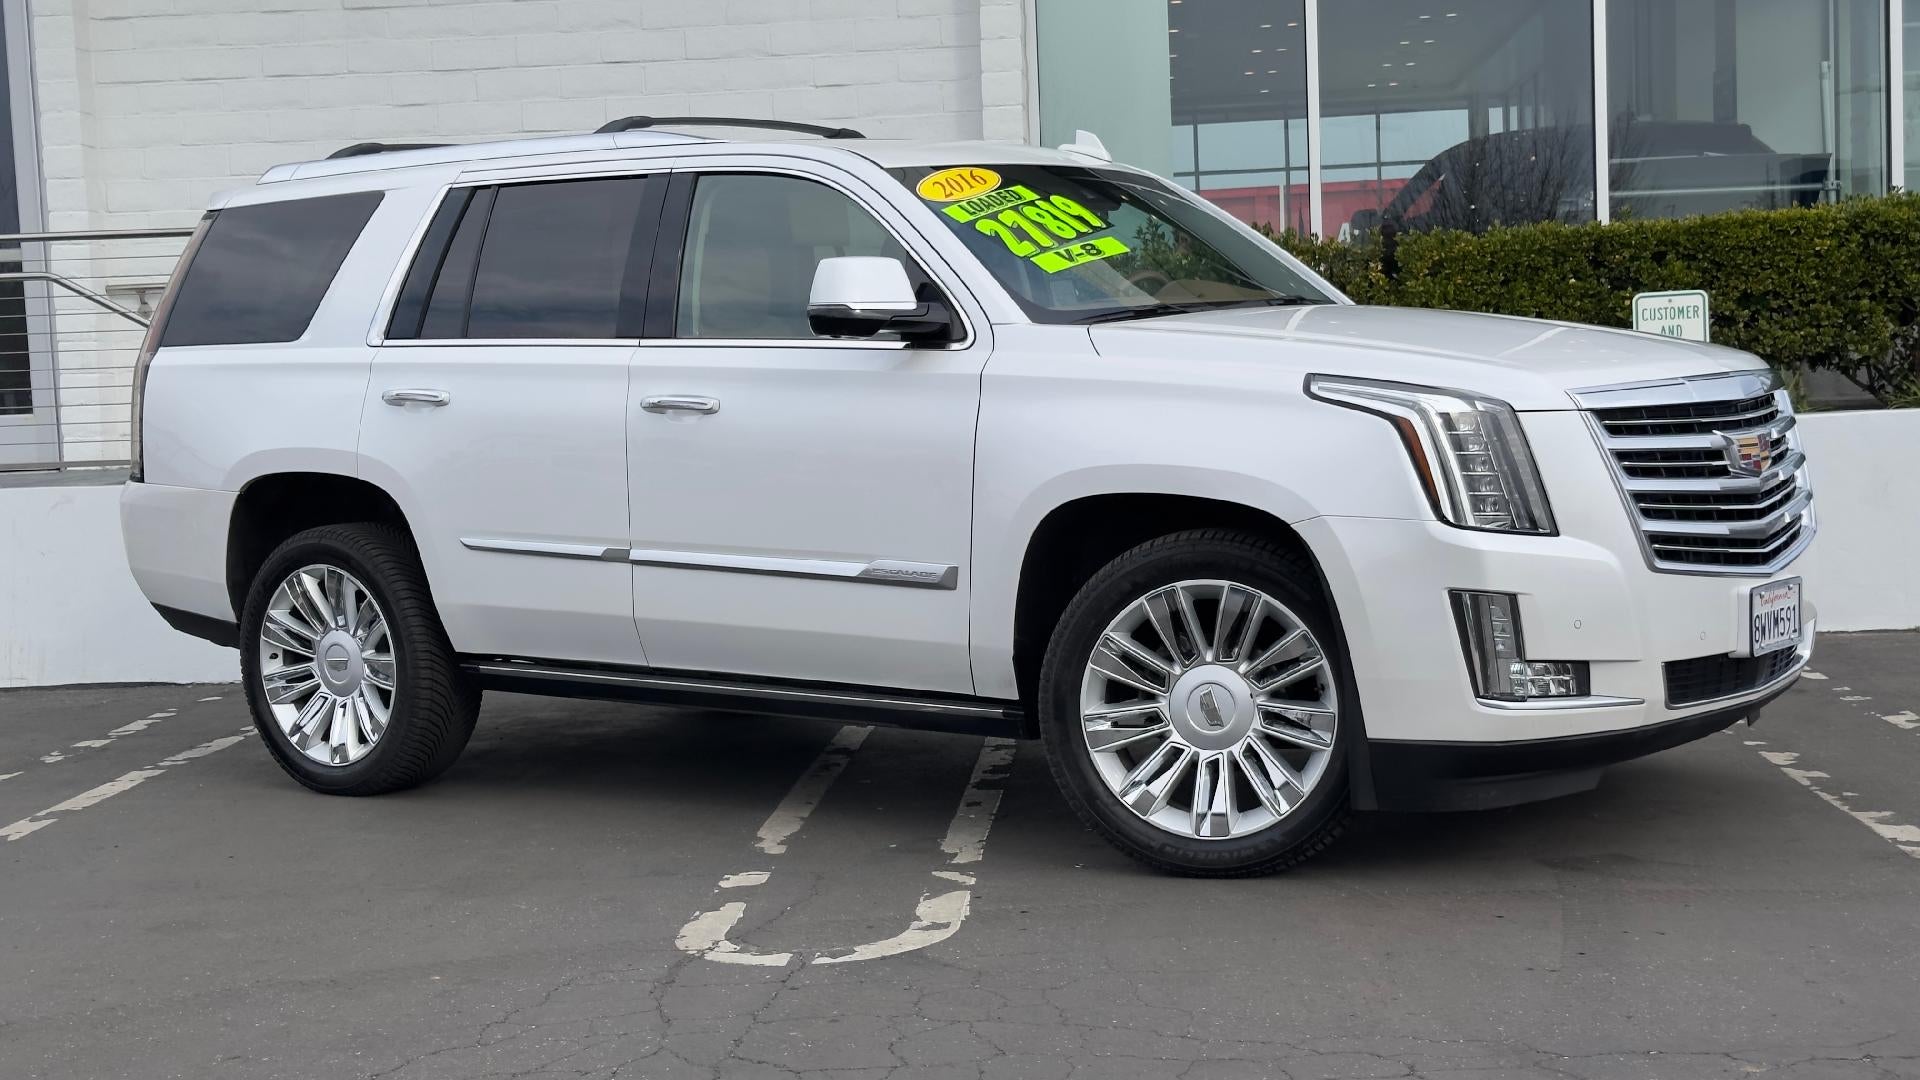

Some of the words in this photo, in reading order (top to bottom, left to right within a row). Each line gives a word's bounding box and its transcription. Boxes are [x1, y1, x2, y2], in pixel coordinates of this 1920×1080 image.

[932, 169, 987, 198] 2016
[956, 188, 1024, 217] LOADED
[975, 195, 1105, 258] 27819
[1053, 242, 1105, 264] V-8
[1641, 305, 1700, 321] CUSTOMER
[1660, 324, 1683, 337] AND
[871, 568, 937, 580] ESCALADE
[1754, 604, 1797, 644] 8WVM591
